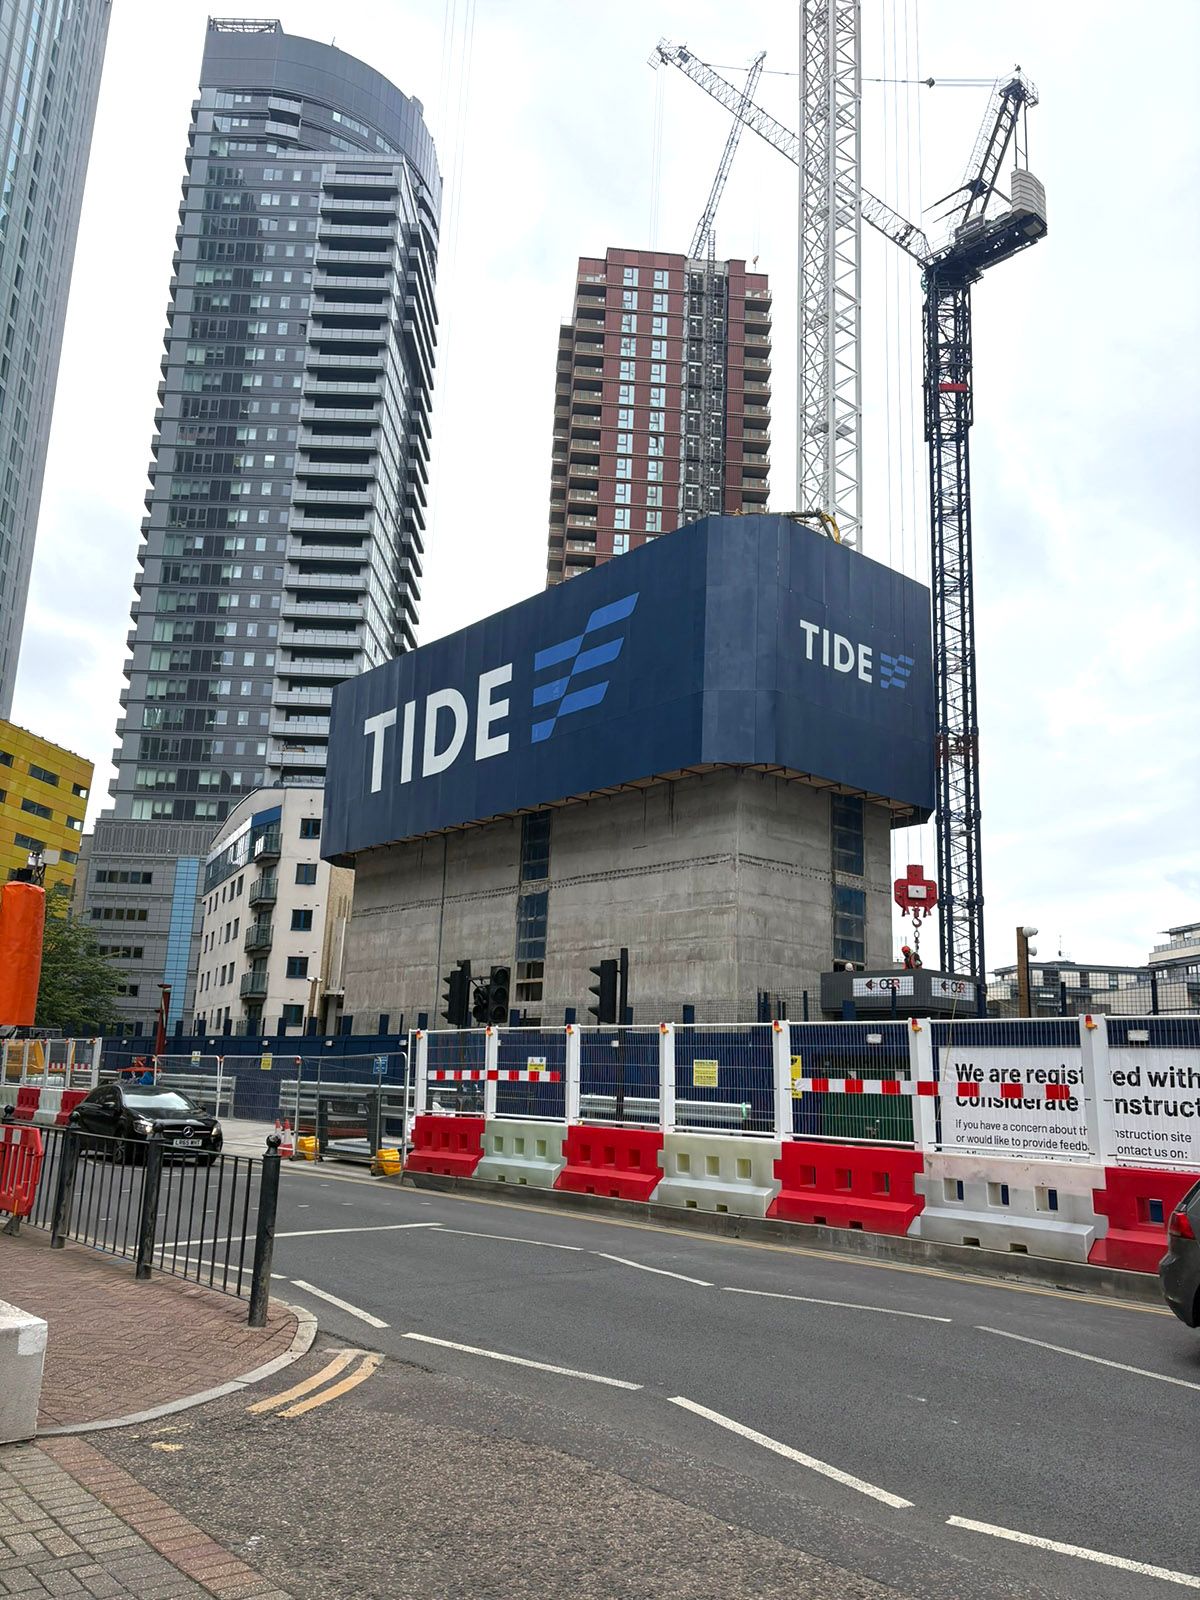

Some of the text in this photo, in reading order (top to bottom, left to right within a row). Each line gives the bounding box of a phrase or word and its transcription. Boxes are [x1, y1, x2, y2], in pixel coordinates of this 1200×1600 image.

[800, 619, 872, 683] TIDE
[364, 663, 512, 793] TIDE
[955, 1064, 984, 1082] We
[989, 1068, 1020, 1083] are
[963, 1121, 979, 1131] you
[980, 1120, 1000, 1131] have
[1002, 1123, 1008, 1131] a
[1010, 1123, 1047, 1133] concern
[1049, 1124, 1076, 1135] about
[1170, 1131, 1192, 1142] site
[967, 1135, 992, 1144] would
[994, 1136, 1009, 1145] like
[1012, 1137, 1020, 1146] to
[1023, 1139, 1058, 1149] provide
[1060, 1140, 1089, 1151] feedb
[1117, 1146, 1152, 1156] ontact
[1154, 1149, 1168, 1158] us
[1170, 1150, 1188, 1159] on:
